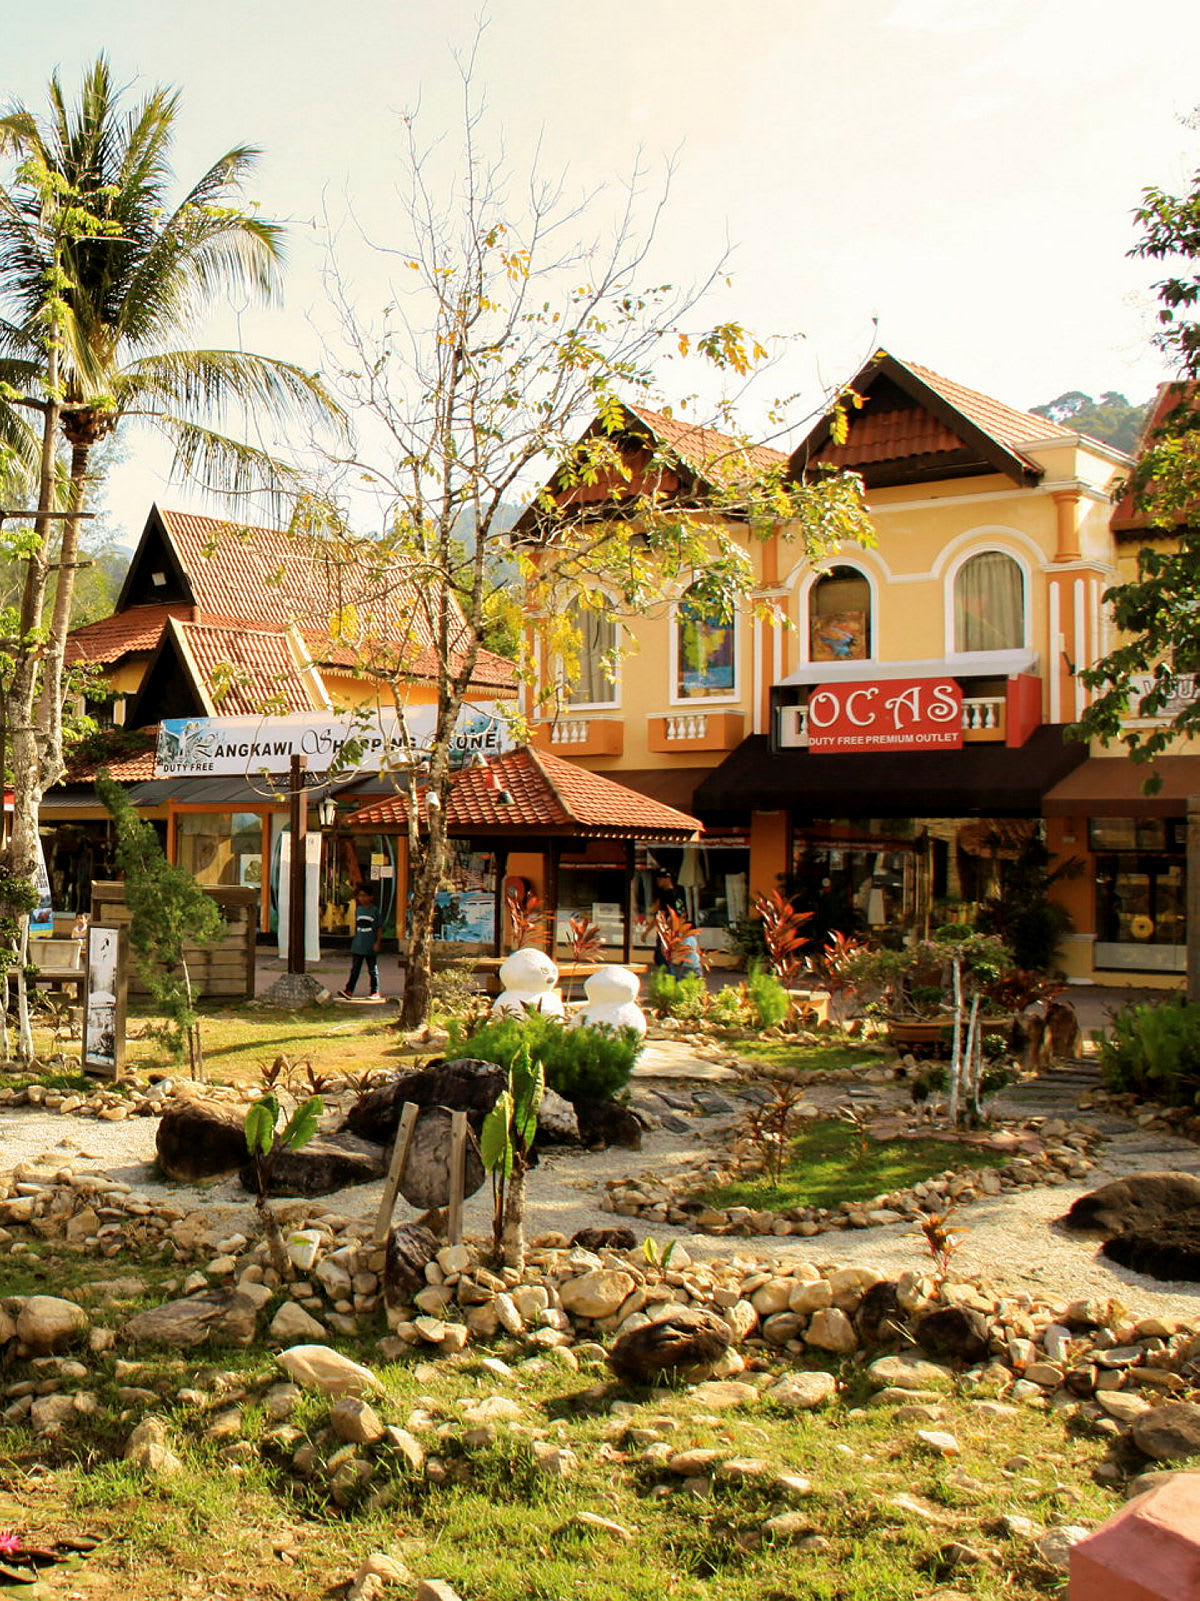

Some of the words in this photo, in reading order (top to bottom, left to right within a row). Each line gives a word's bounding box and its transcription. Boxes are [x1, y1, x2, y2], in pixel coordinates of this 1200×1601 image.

[809, 685, 959, 730] OCAS
[301, 728, 417, 755] SHPPNG
[809, 736, 835, 746] DUTY
[837, 735, 865, 745] FREE
[866, 734, 914, 744] PREMIUM
[915, 732, 959, 743] OUTLET
[163, 763, 188, 773] DUTY
[190, 762, 214, 771] FREE
